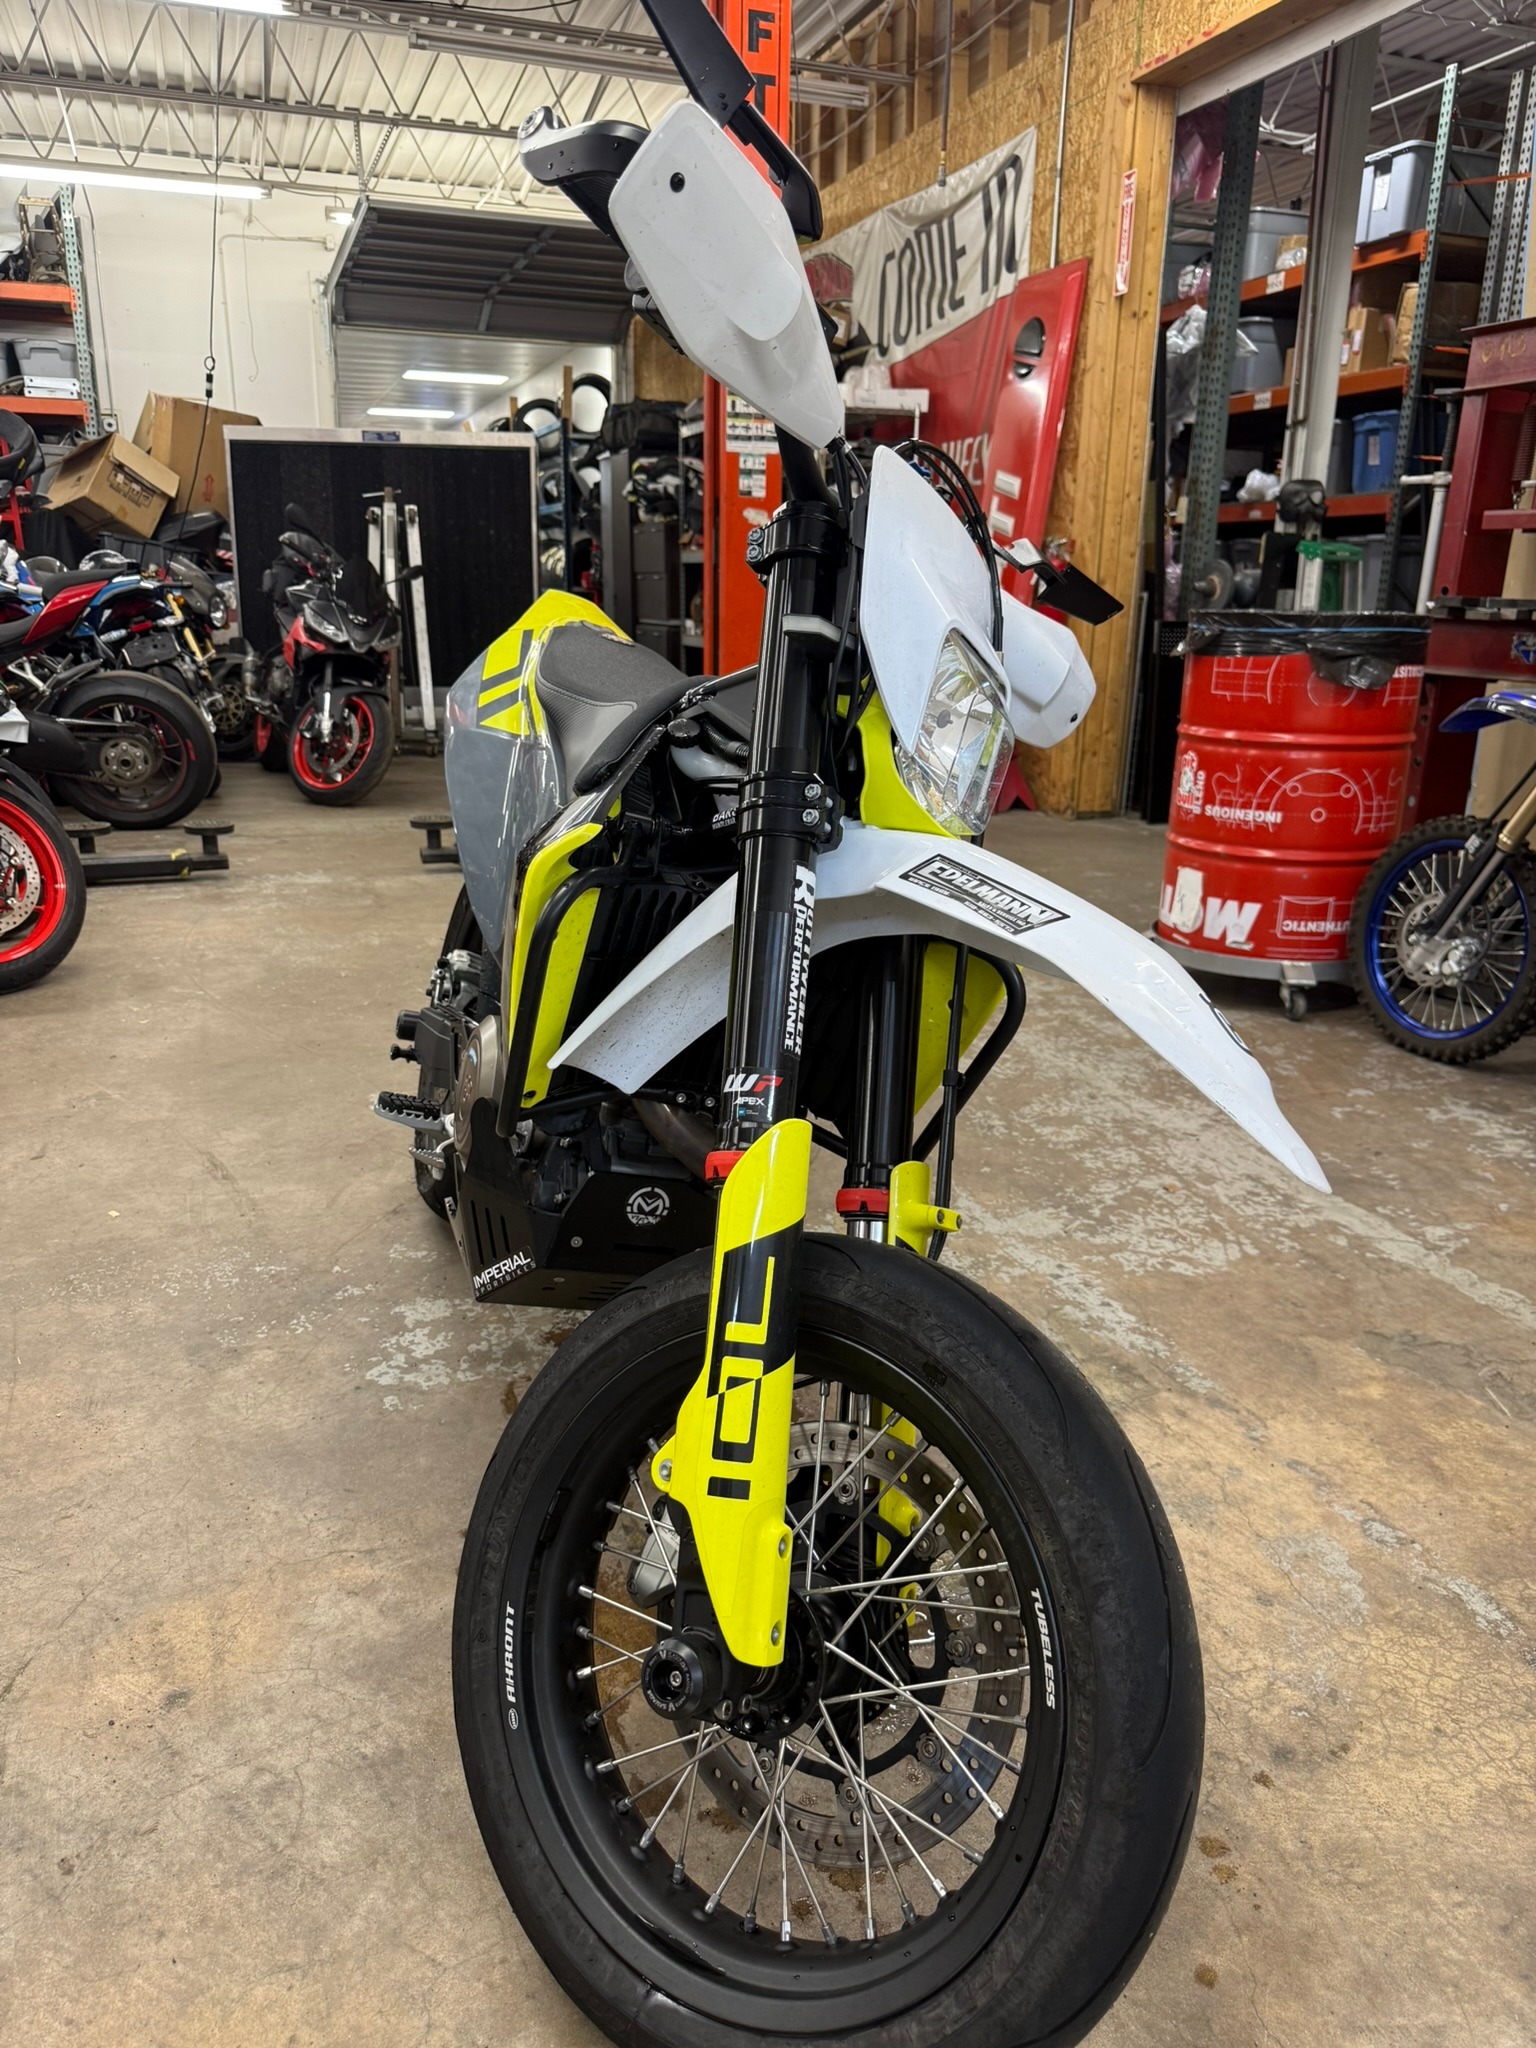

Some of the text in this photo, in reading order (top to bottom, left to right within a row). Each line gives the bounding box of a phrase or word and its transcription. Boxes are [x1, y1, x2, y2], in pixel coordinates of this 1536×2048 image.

[878, 214, 966, 358] COME
[981, 154, 1023, 295] IN
[1204, 804, 1282, 824] INGENIOUS
[917, 861, 1054, 924] EDELMANN
[1282, 919, 1351, 933] UTHENTIC
[785, 903, 807, 1052] PERFORMANCE
[723, 1073, 783, 1092] WP
[734, 1096, 766, 1107] APEX
[473, 1251, 531, 1289] IMPERIAL
[475, 1260, 536, 1297] SPORTBIKES
[504, 1601, 516, 1703] AKRONT
[1031, 1588, 1055, 1709] TUBELESS
